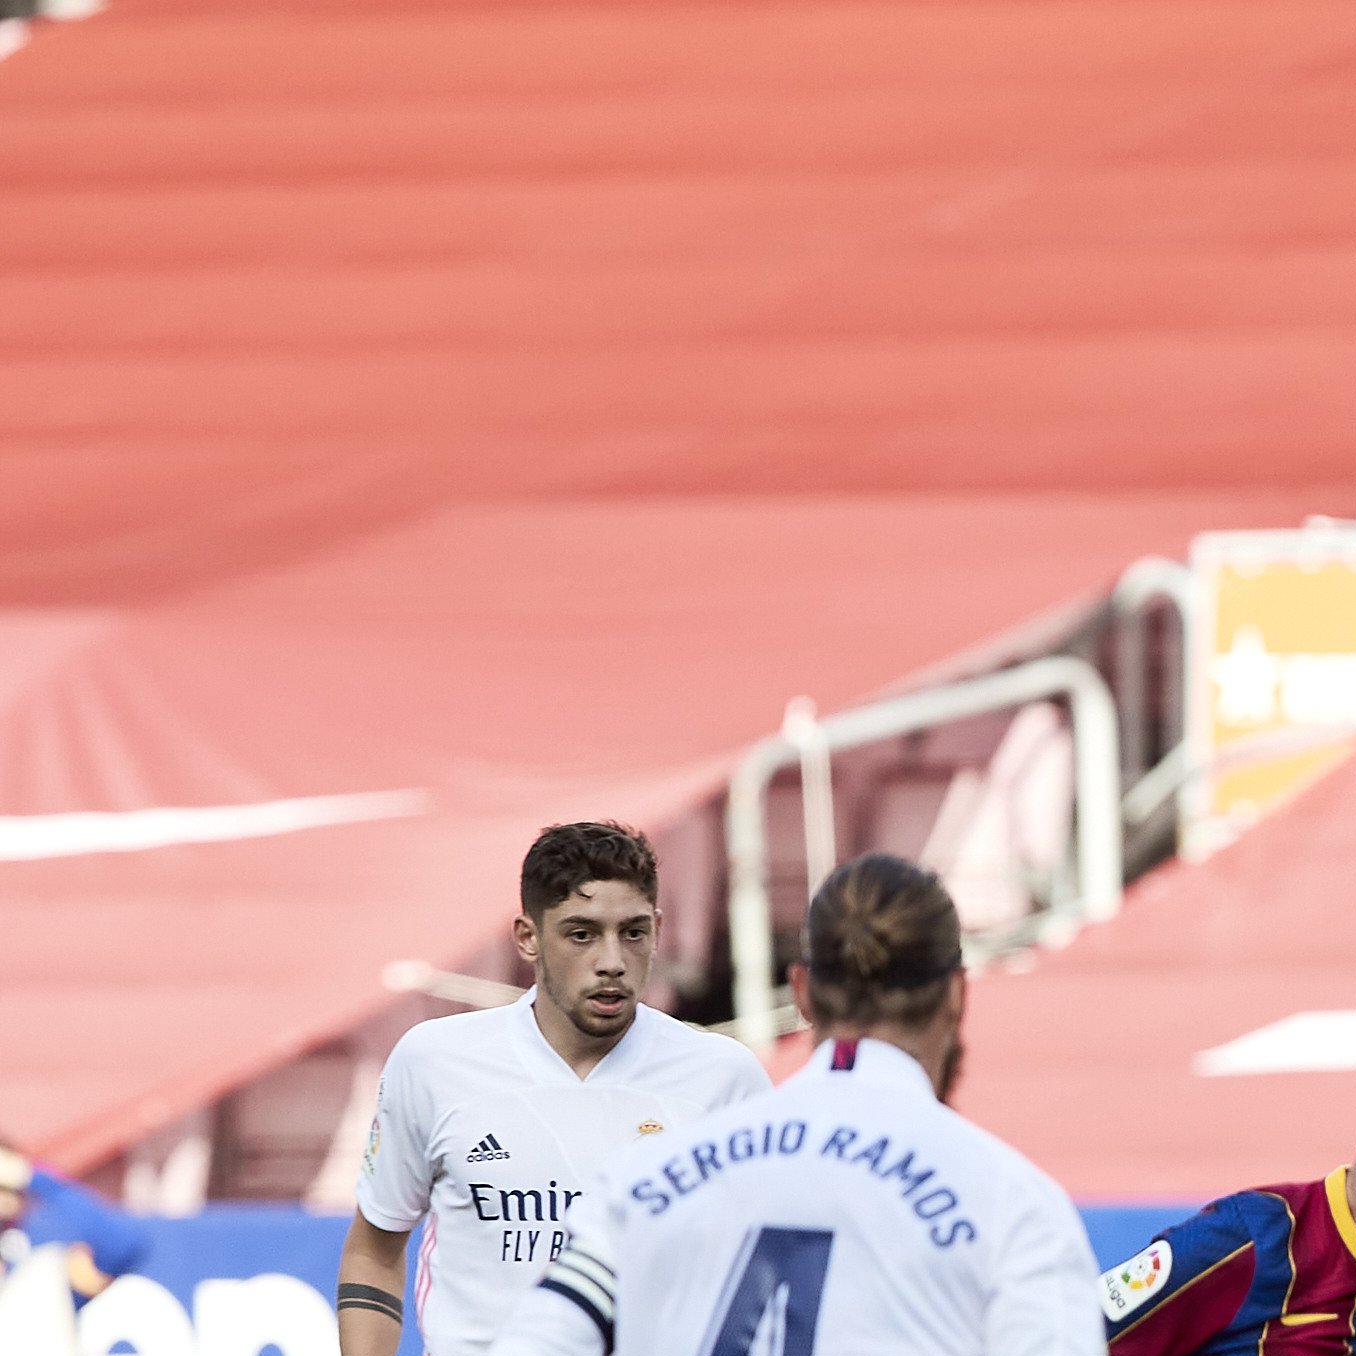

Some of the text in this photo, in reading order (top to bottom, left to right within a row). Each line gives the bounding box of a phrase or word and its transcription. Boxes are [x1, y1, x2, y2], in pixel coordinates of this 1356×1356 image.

[466, 1149, 511, 1163] adidas
[469, 1180, 582, 1222] Emir
[631, 1121, 976, 1248] SERGIO RAMOS
[502, 1230, 540, 1262] FLY
